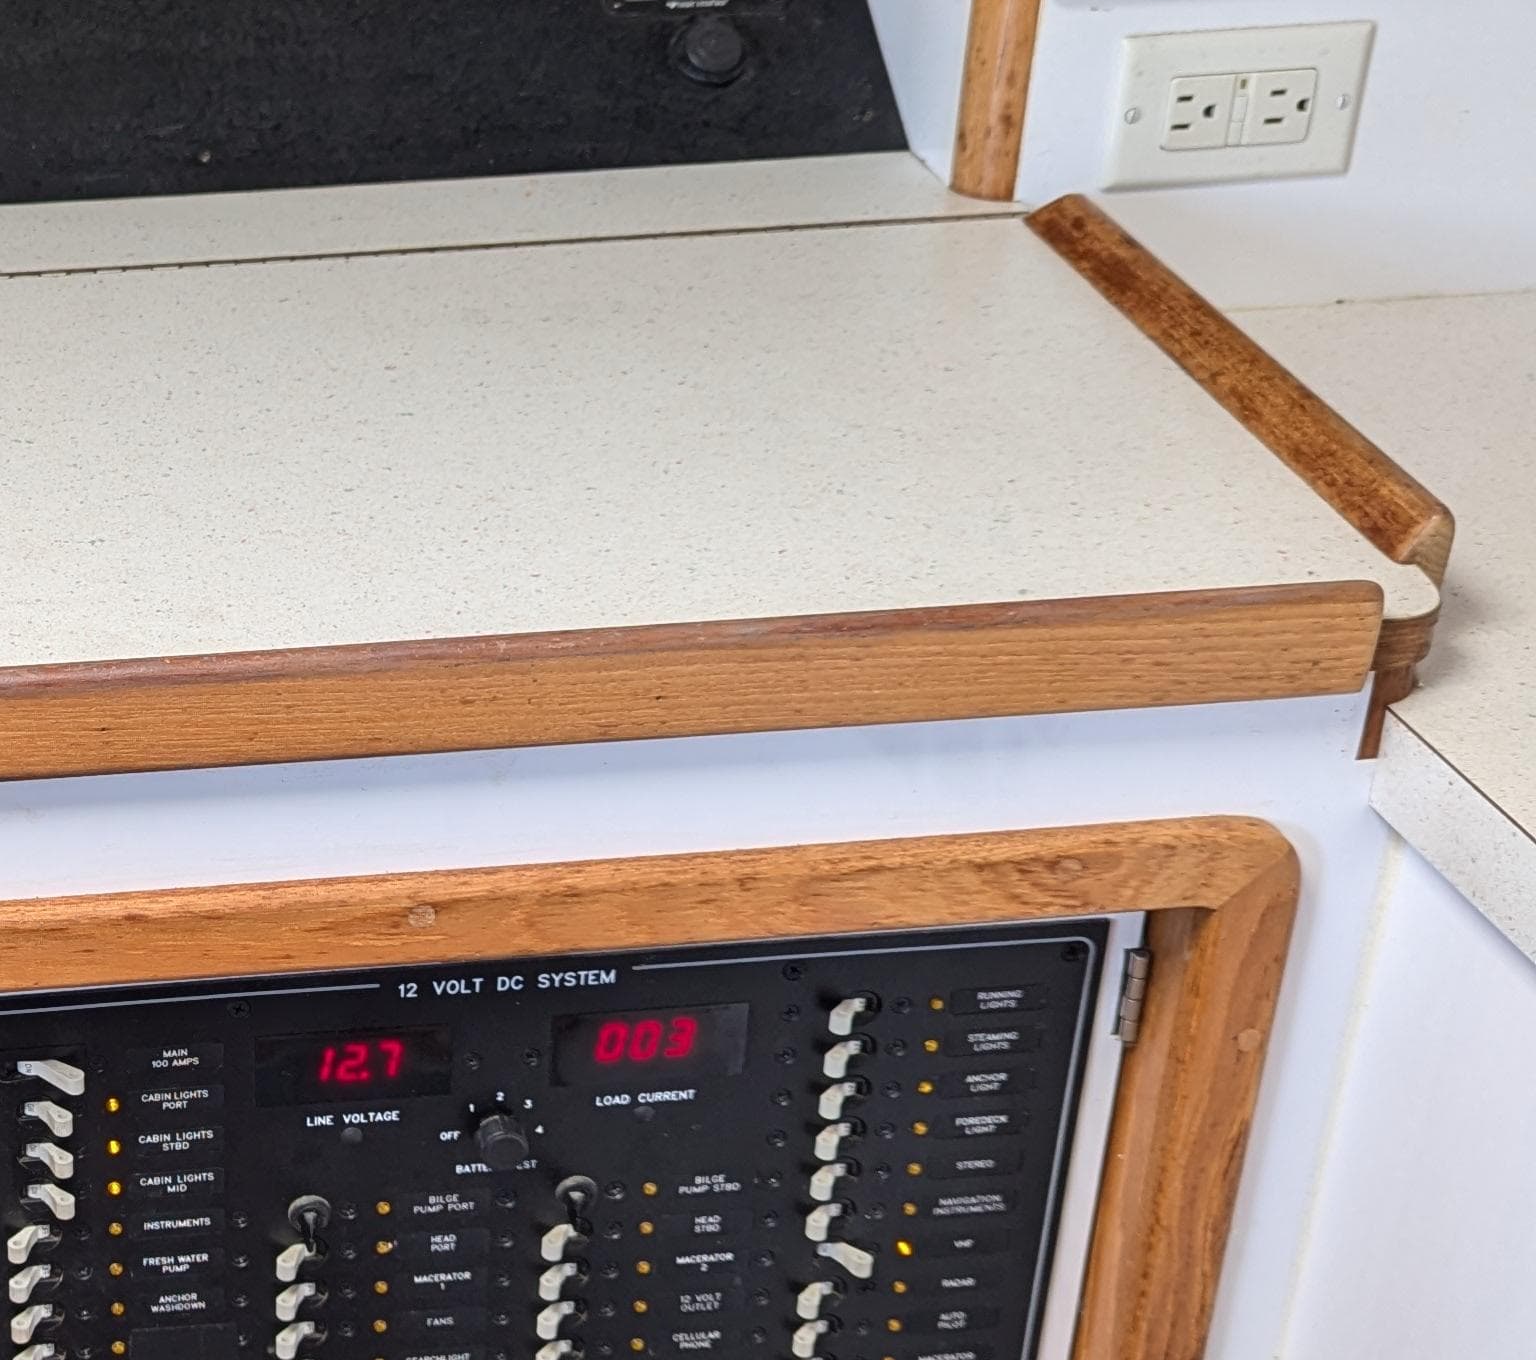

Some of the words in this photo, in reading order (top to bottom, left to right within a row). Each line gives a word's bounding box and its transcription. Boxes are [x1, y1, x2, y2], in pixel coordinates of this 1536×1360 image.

[398, 983, 418, 998] 12
[432, 977, 484, 996] VOLT
[497, 976, 524, 991] DC
[537, 969, 617, 988] SYSTEM
[594, 1017, 697, 1063] 003
[163, 1048, 188, 1058] MAIN
[152, 1060, 169, 1069] 100
[172, 1057, 200, 1067] AMPS
[320, 1040, 404, 1082] 12.7
[141, 1092, 171, 1102] CABIN
[174, 1090, 209, 1100] LIGHTS
[495, 1091, 505, 1101] 2
[595, 1094, 631, 1107] LOAD
[637, 1089, 697, 1103] CURRENT
[162, 1101, 188, 1110] PORT
[523, 1099, 533, 1109] 3
[306, 1115, 334, 1127] LINE
[343, 1110, 401, 1125] VOLTAGE
[138, 1133, 171, 1144] CABIN
[175, 1130, 214, 1141] LIGHTS
[439, 1130, 461, 1141] OFF
[162, 1141, 190, 1151] STBD
[140, 1175, 172, 1186] CABIN
[177, 1172, 215, 1183] LIGHTS
[694, 1174, 726, 1184] BILGE
[167, 1183, 187, 1193] MID
[678, 1184, 710, 1194] PUMP
[428, 1194, 460, 1204] BILGE
[413, 1204, 444, 1214] PUMP
[447, 1201, 475, 1211] PORT
[143, 1217, 211, 1230] INSTRUMENTS
[694, 1214, 722, 1224] HEAD
[430, 1233, 457, 1243] HEAD
[430, 1242, 456, 1253] PORT
[142, 1256, 174, 1266] FRESH
[177, 1253, 209, 1263] WATER
[675, 1252, 735, 1265] MACERATOR
[162, 1264, 190, 1273] PUMP
[413, 1271, 472, 1284] MACERATOR
[158, 1292, 198, 1304] ANCHOR
[694, 1292, 722, 1302] VOLT
[150, 1301, 206, 1313] WASHDOWN
[680, 1301, 720, 1312] OUTLET
[426, 1316, 454, 1327] FANS
[672, 1330, 721, 1342] CELLULAR
